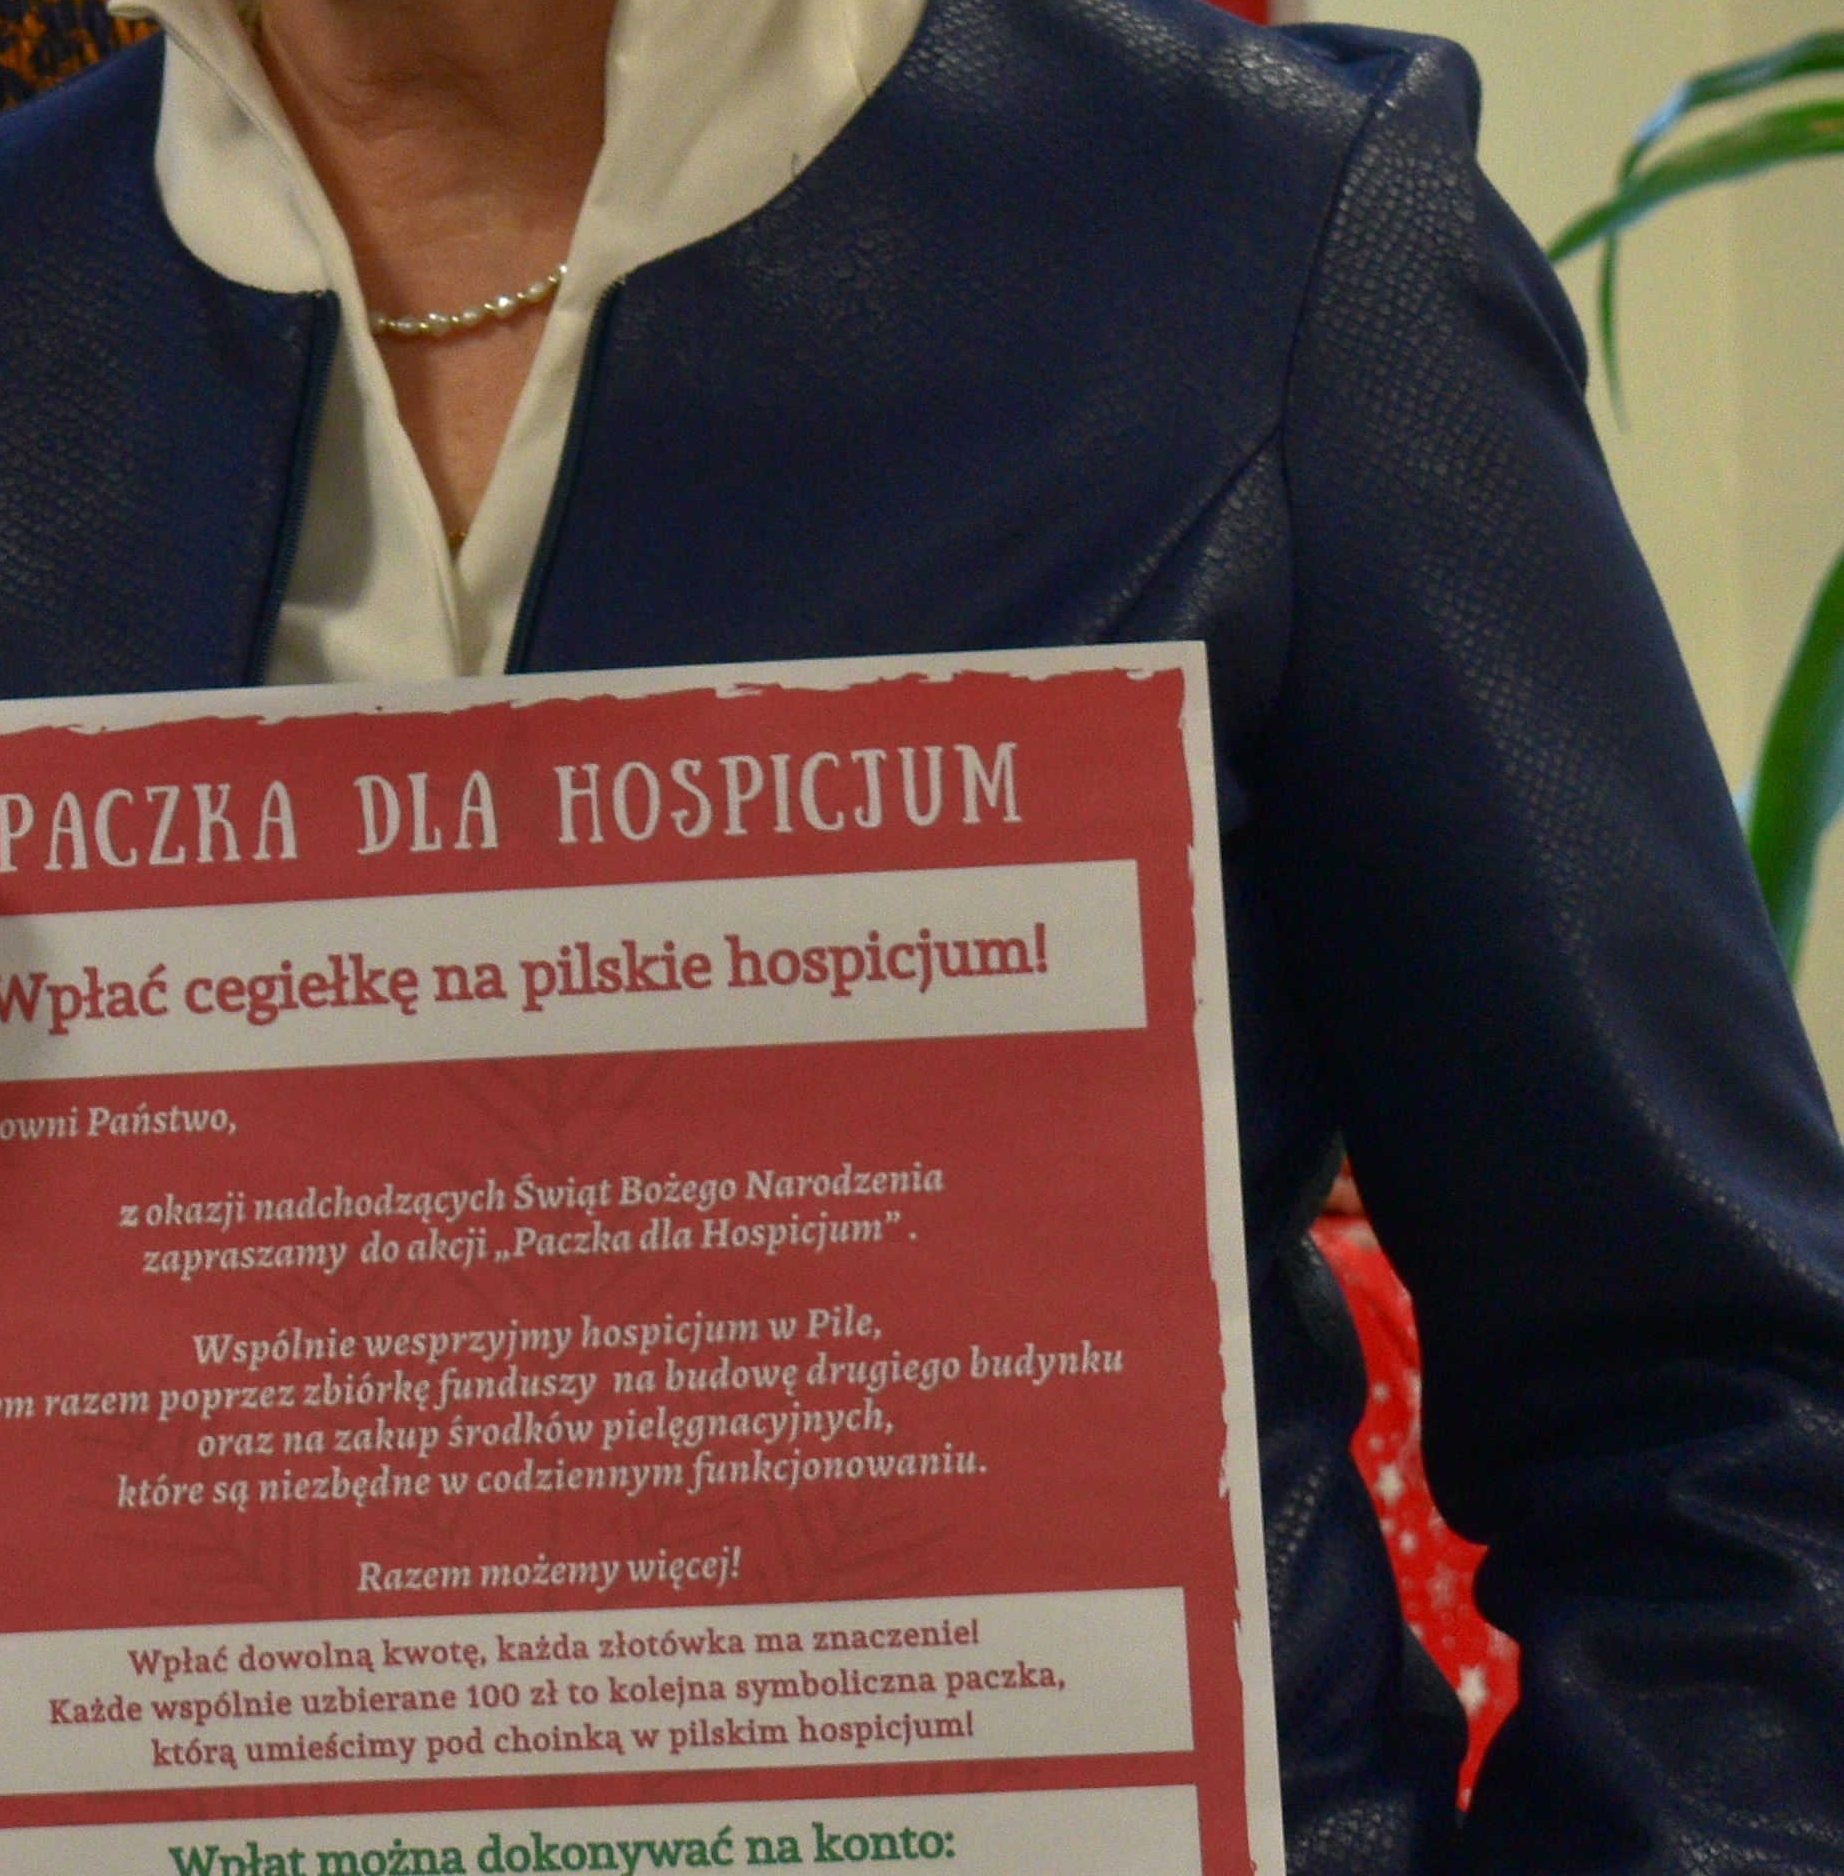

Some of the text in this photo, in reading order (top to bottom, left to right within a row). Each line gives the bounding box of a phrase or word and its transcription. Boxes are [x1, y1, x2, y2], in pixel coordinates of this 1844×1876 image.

[353, 770, 499, 856] DLA
[554, 741, 1022, 845] HOSPICJUM
[184, 952, 419, 1027] cegiełkę
[432, 962, 508, 1003] na
[519, 939, 713, 1013] pilskie
[724, 922, 1048, 999] hospicjum!
[86, 1102, 237, 1138] Państwo,
[118, 1161, 945, 1232] z okazji nadchodzących Świąt Bożego Narodzenia
[142, 1242, 348, 1283] zapraszamy
[360, 1229, 401, 1264] do
[406, 1226, 487, 1268] akcji
[639, 1216, 693, 1252] dla
[192, 1303, 882, 1372] Wspólnie wesprzyjmy hospicjum w Pile,
[44, 1390, 150, 1417] razem
[158, 1384, 296, 1423] poprzez
[303, 1369, 431, 1412] zbiórkę
[433, 1364, 598, 1412] funduszy
[613, 1370, 657, 1394] na
[665, 1355, 799, 1397] budowę
[805, 1350, 962, 1394] drugiego
[970, 1339, 1124, 1387] budynku
[197, 1396, 894, 1460] oraz na zakup środków pielęgnacyjnych,
[117, 1441, 988, 1514] które są niezbędne w codziennym funkcjonowaniu.
[357, 1545, 742, 1594] Razem możemy więcej!
[127, 1618, 980, 1683] Wpłać dowolną kwotę, każda złotówka ma znaczenie!
[49, 1660, 1066, 1728] Każde wspólnie uzbierane 100 zł to kolejna symboliczna paczka,
[151, 1709, 974, 1771] którą umieścimy pod choinką w pilskim hospicjum!
[168, 1821, 956, 1876] Wpłat można dokonywać na konto:
